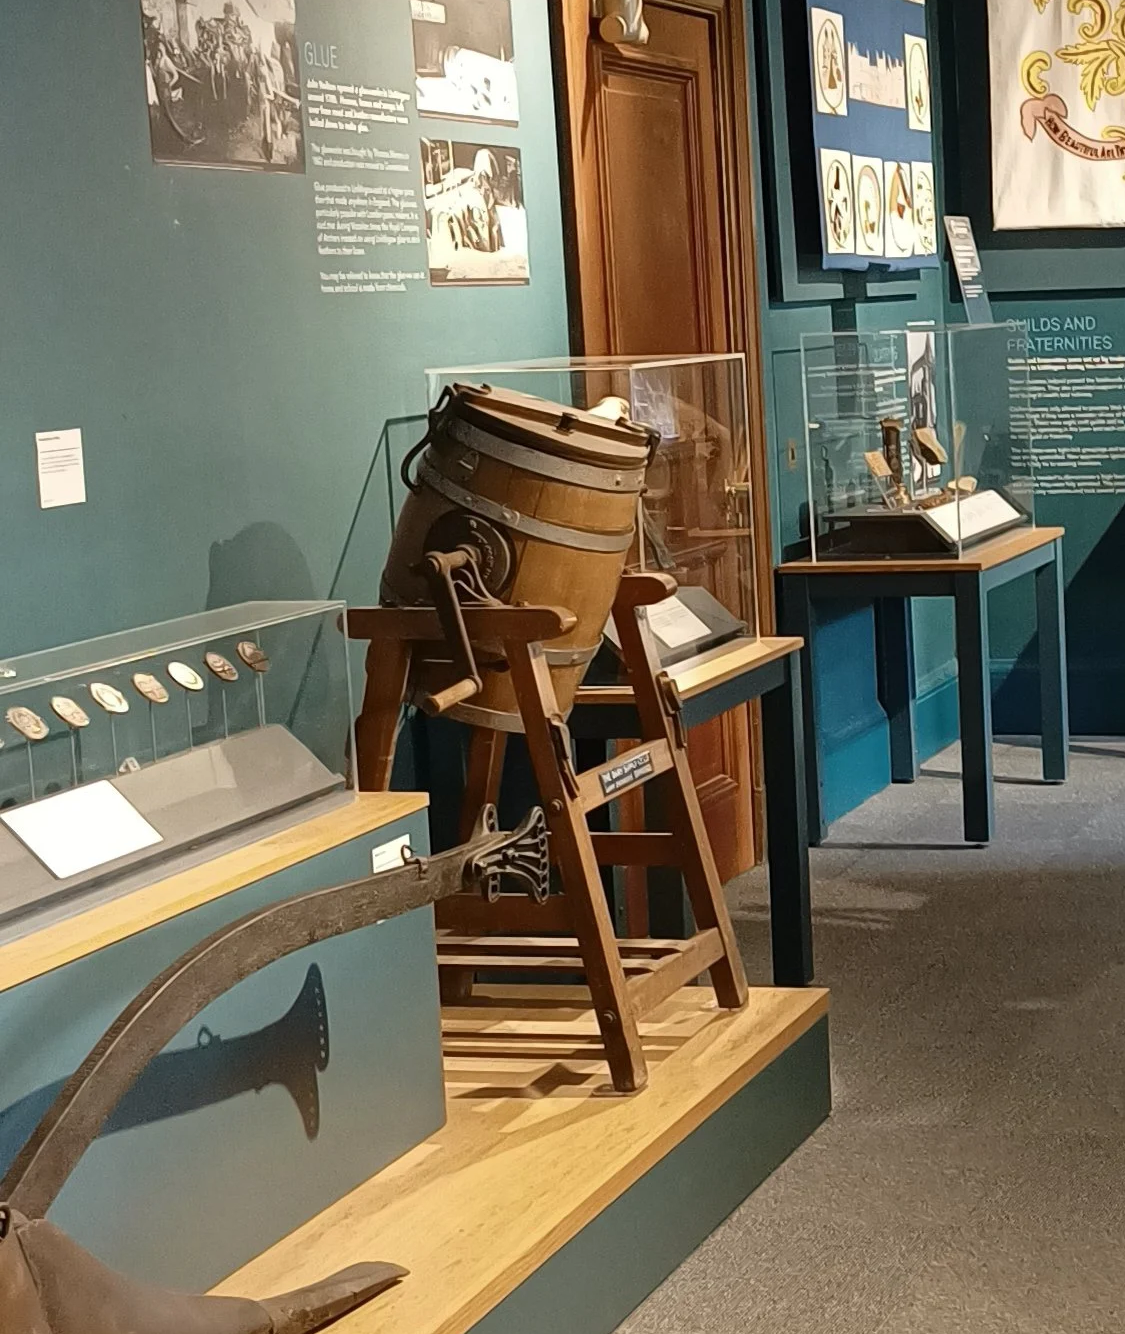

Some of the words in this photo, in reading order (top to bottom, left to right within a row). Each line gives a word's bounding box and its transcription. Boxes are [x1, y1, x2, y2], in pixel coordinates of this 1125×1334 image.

[304, 41, 339, 69] GLUE
[1006, 317, 1061, 332] GUILDS
[1063, 316, 1096, 331] AND
[1007, 335, 1113, 352] FRATERNITIES
